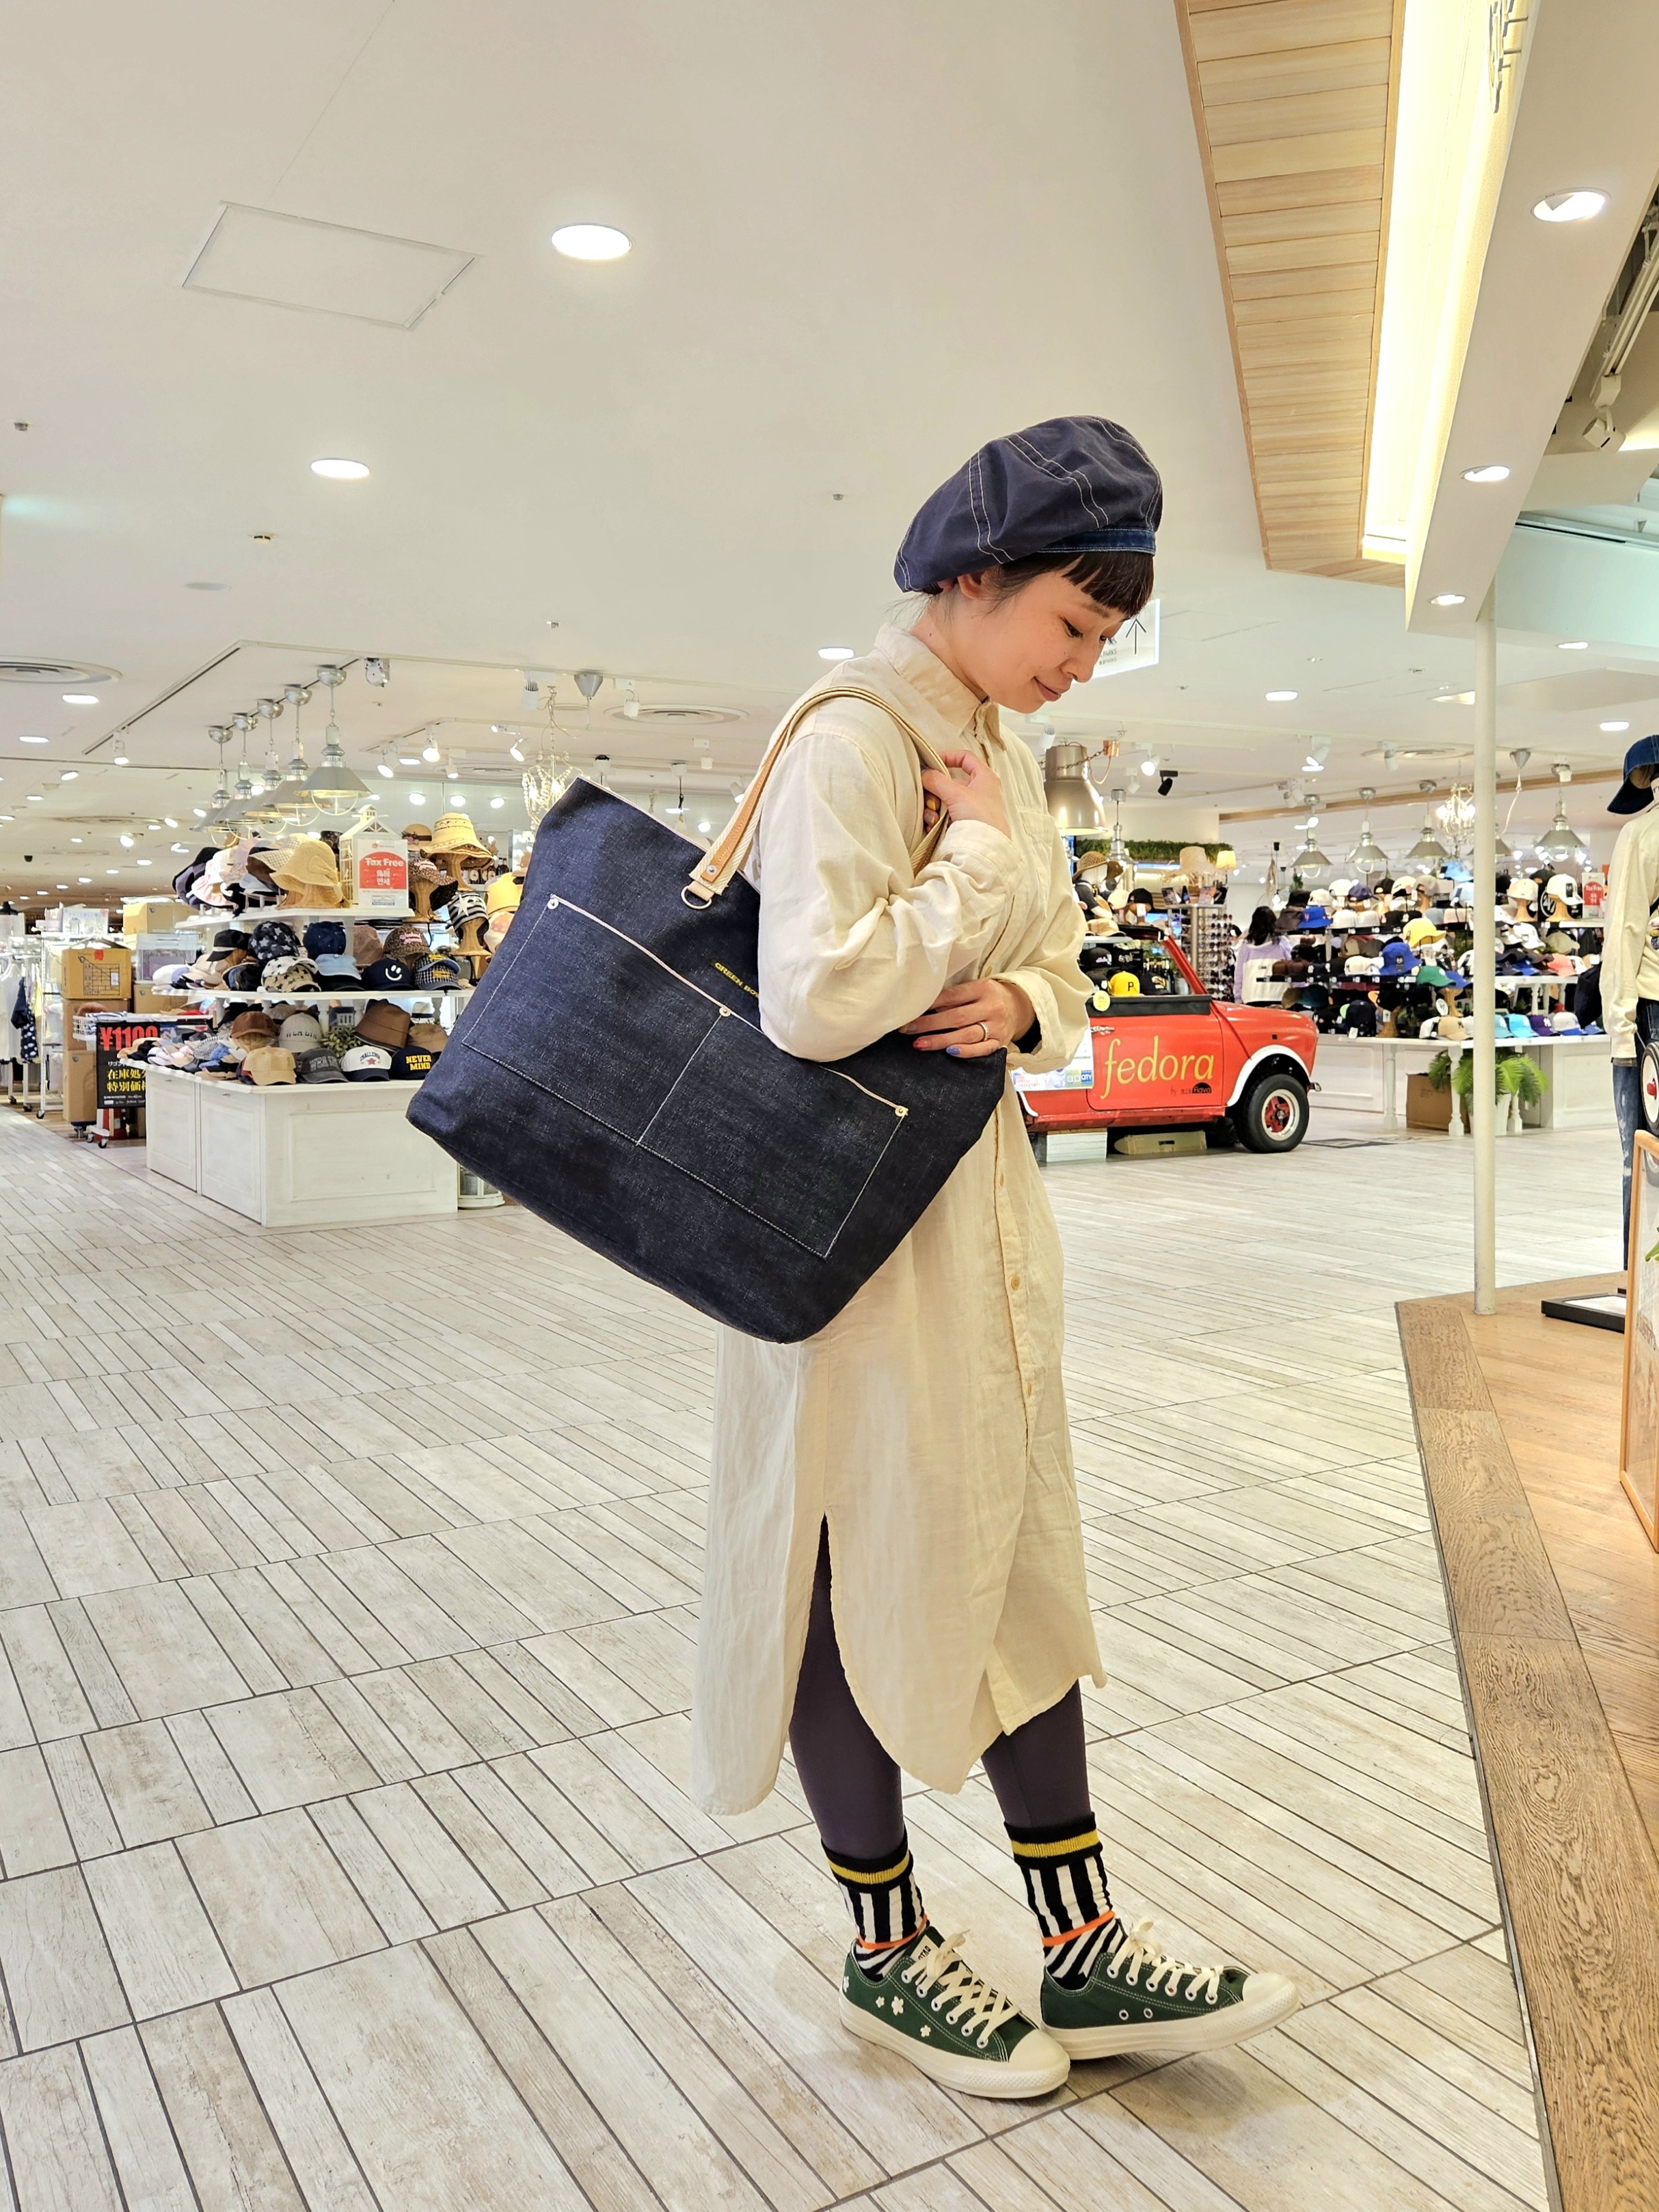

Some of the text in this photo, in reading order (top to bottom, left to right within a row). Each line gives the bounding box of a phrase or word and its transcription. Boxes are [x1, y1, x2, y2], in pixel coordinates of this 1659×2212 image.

[365, 857, 381, 866] Tax
[383, 858, 404, 867] Free
[714, 962, 743, 986] GREEN
[1127, 981, 1134, 991] P
[406, 1055, 431, 1064] NEVER
[410, 1062, 431, 1070] MIND
[1100, 1035, 1215, 1100] fedora
[1170, 1085, 1176, 1097] by
